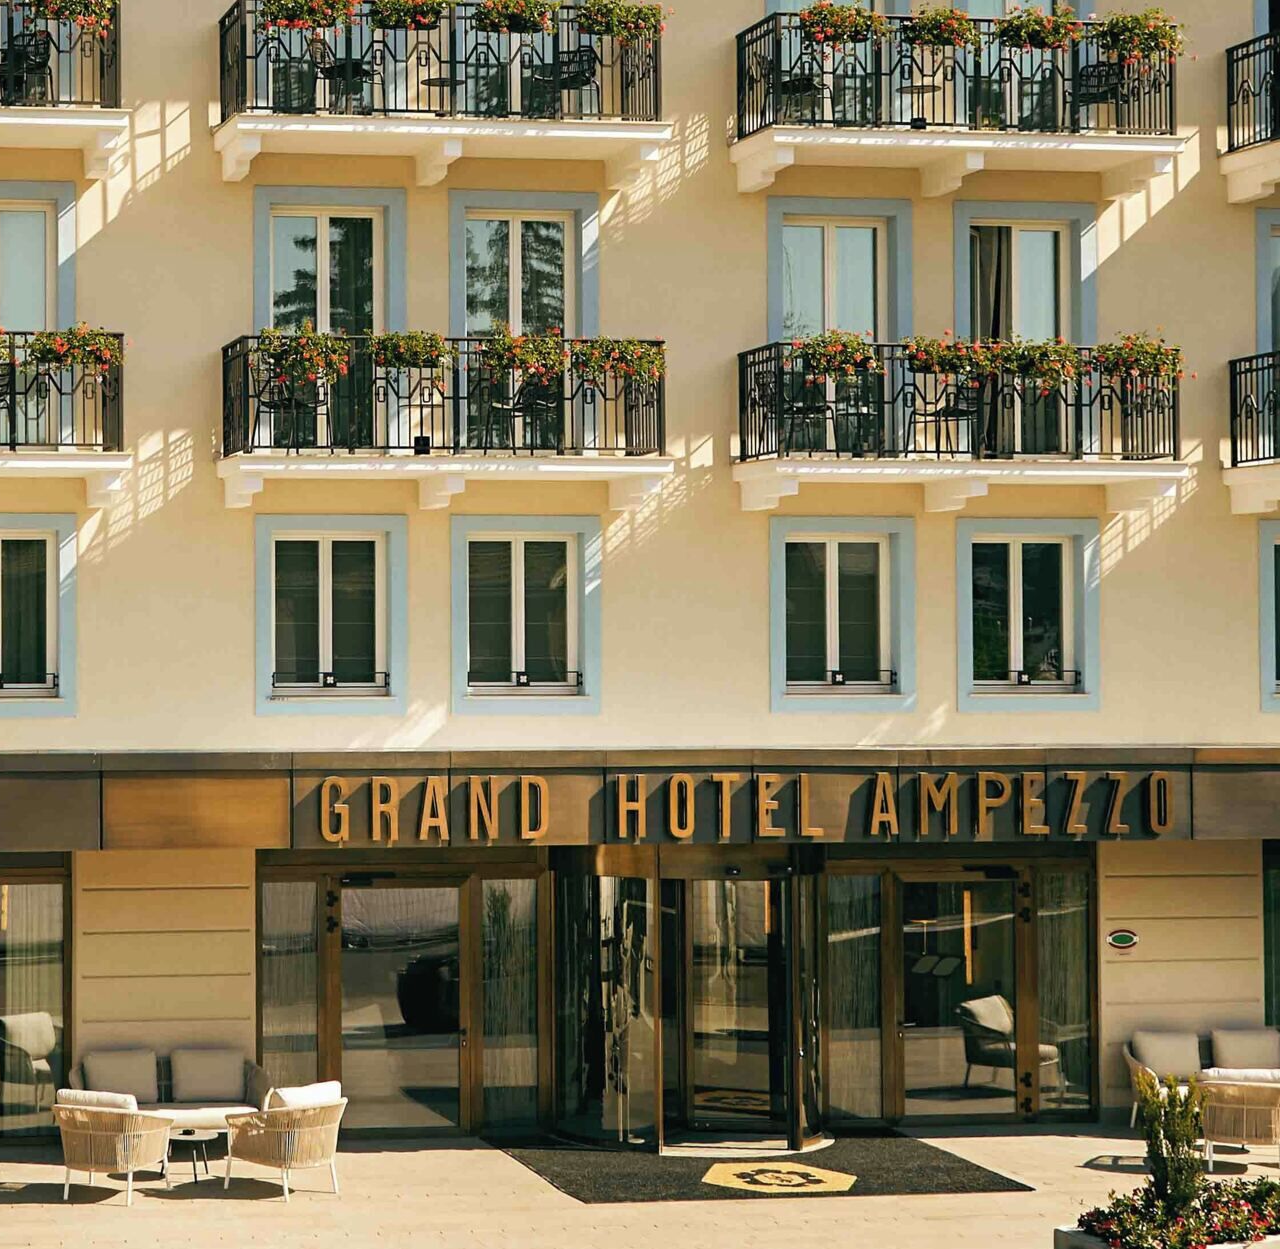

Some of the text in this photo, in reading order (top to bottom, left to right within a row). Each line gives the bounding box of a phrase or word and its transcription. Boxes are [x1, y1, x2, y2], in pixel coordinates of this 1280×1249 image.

[320, 771, 1174, 843] GRAND HOTEL AMPEZZO
